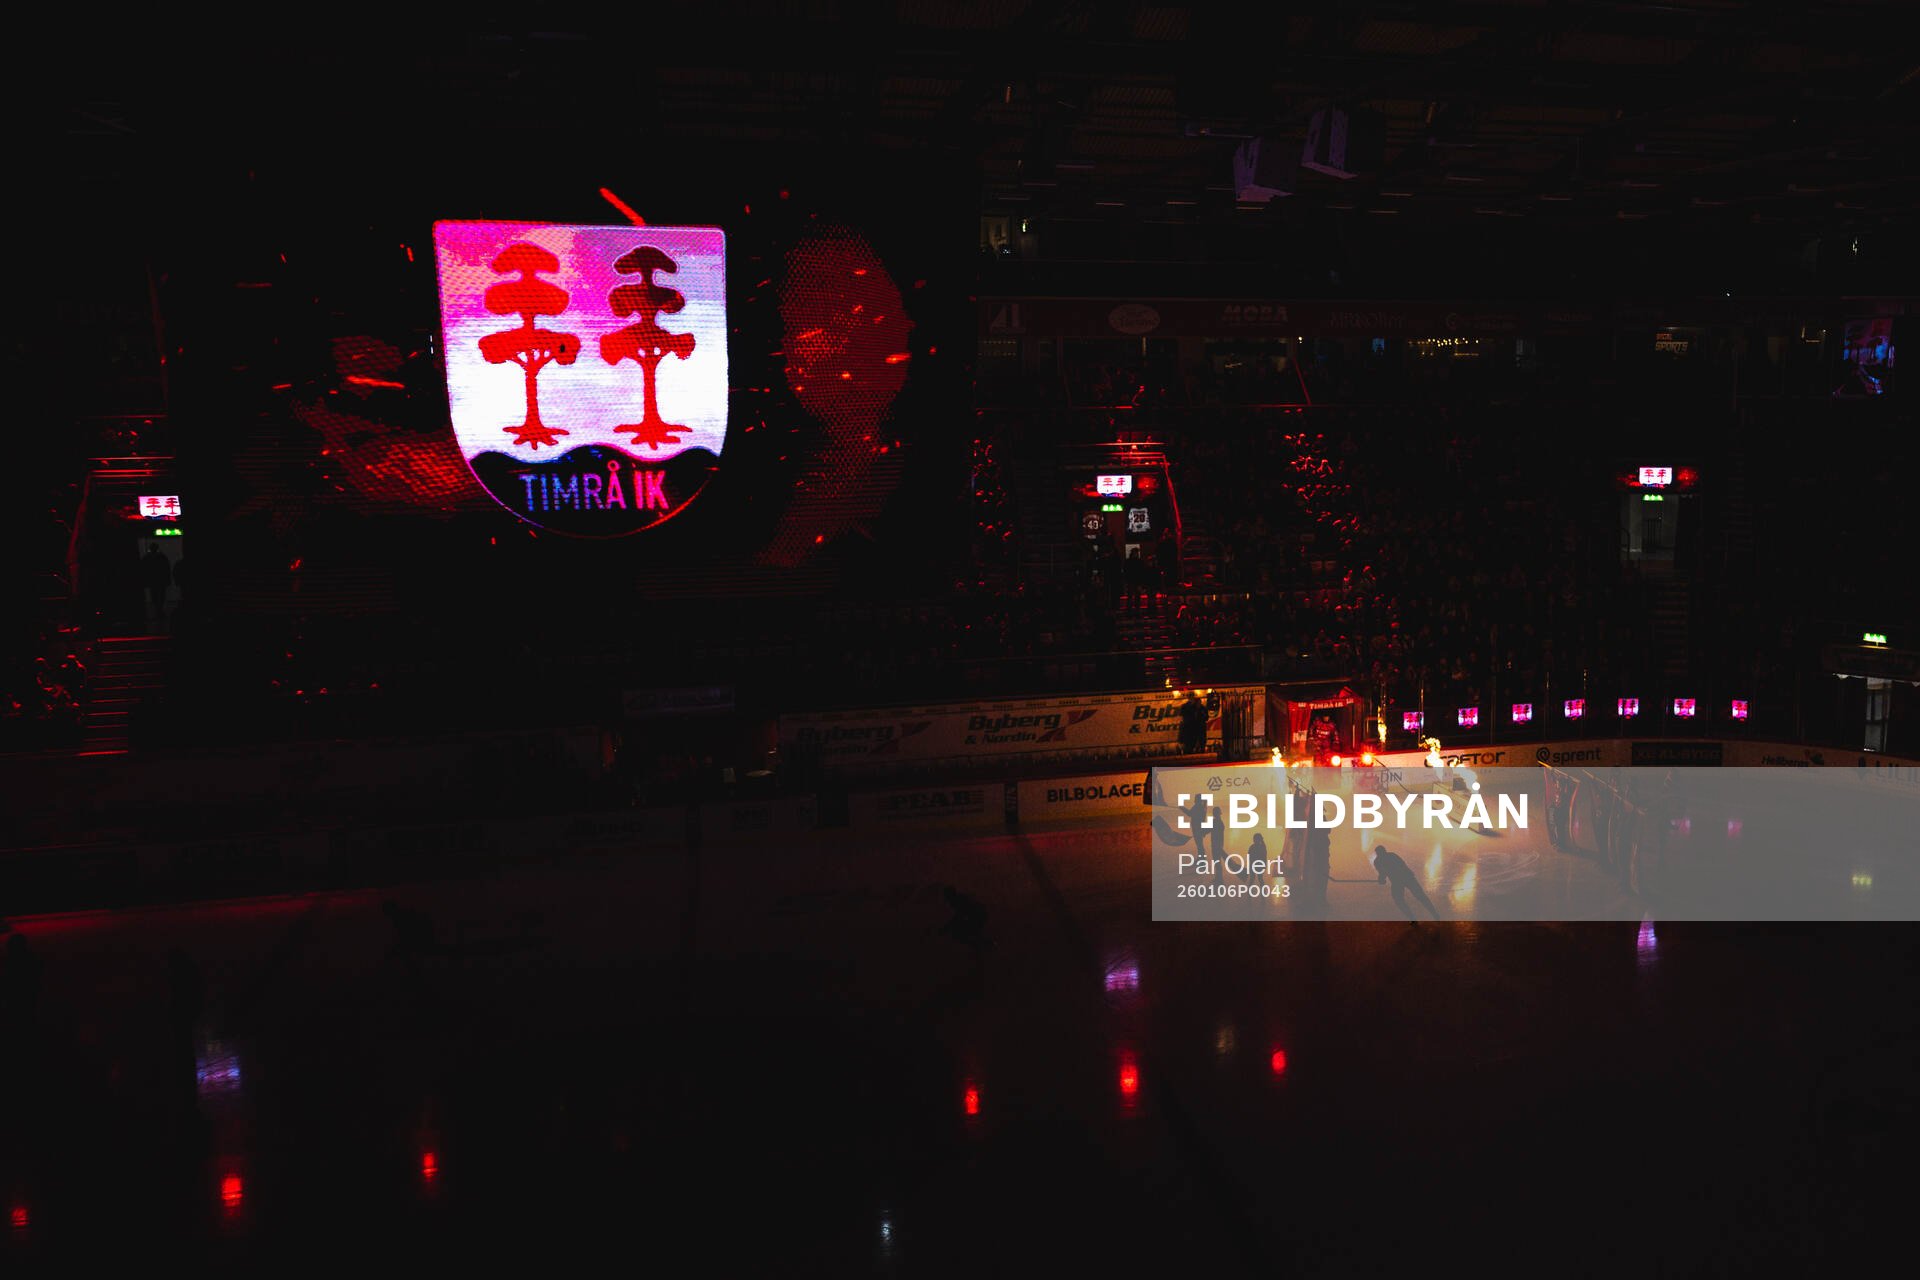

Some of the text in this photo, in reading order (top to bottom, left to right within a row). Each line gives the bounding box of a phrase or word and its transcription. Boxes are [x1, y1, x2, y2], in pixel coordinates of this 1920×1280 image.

[518, 460, 670, 511] TIMRÅ IK
[967, 713, 1061, 733] Byberg
[1552, 748, 1601, 765] sprent
[1225, 777, 1251, 787] SCA
[1047, 784, 1147, 803] BILBOLAGE
